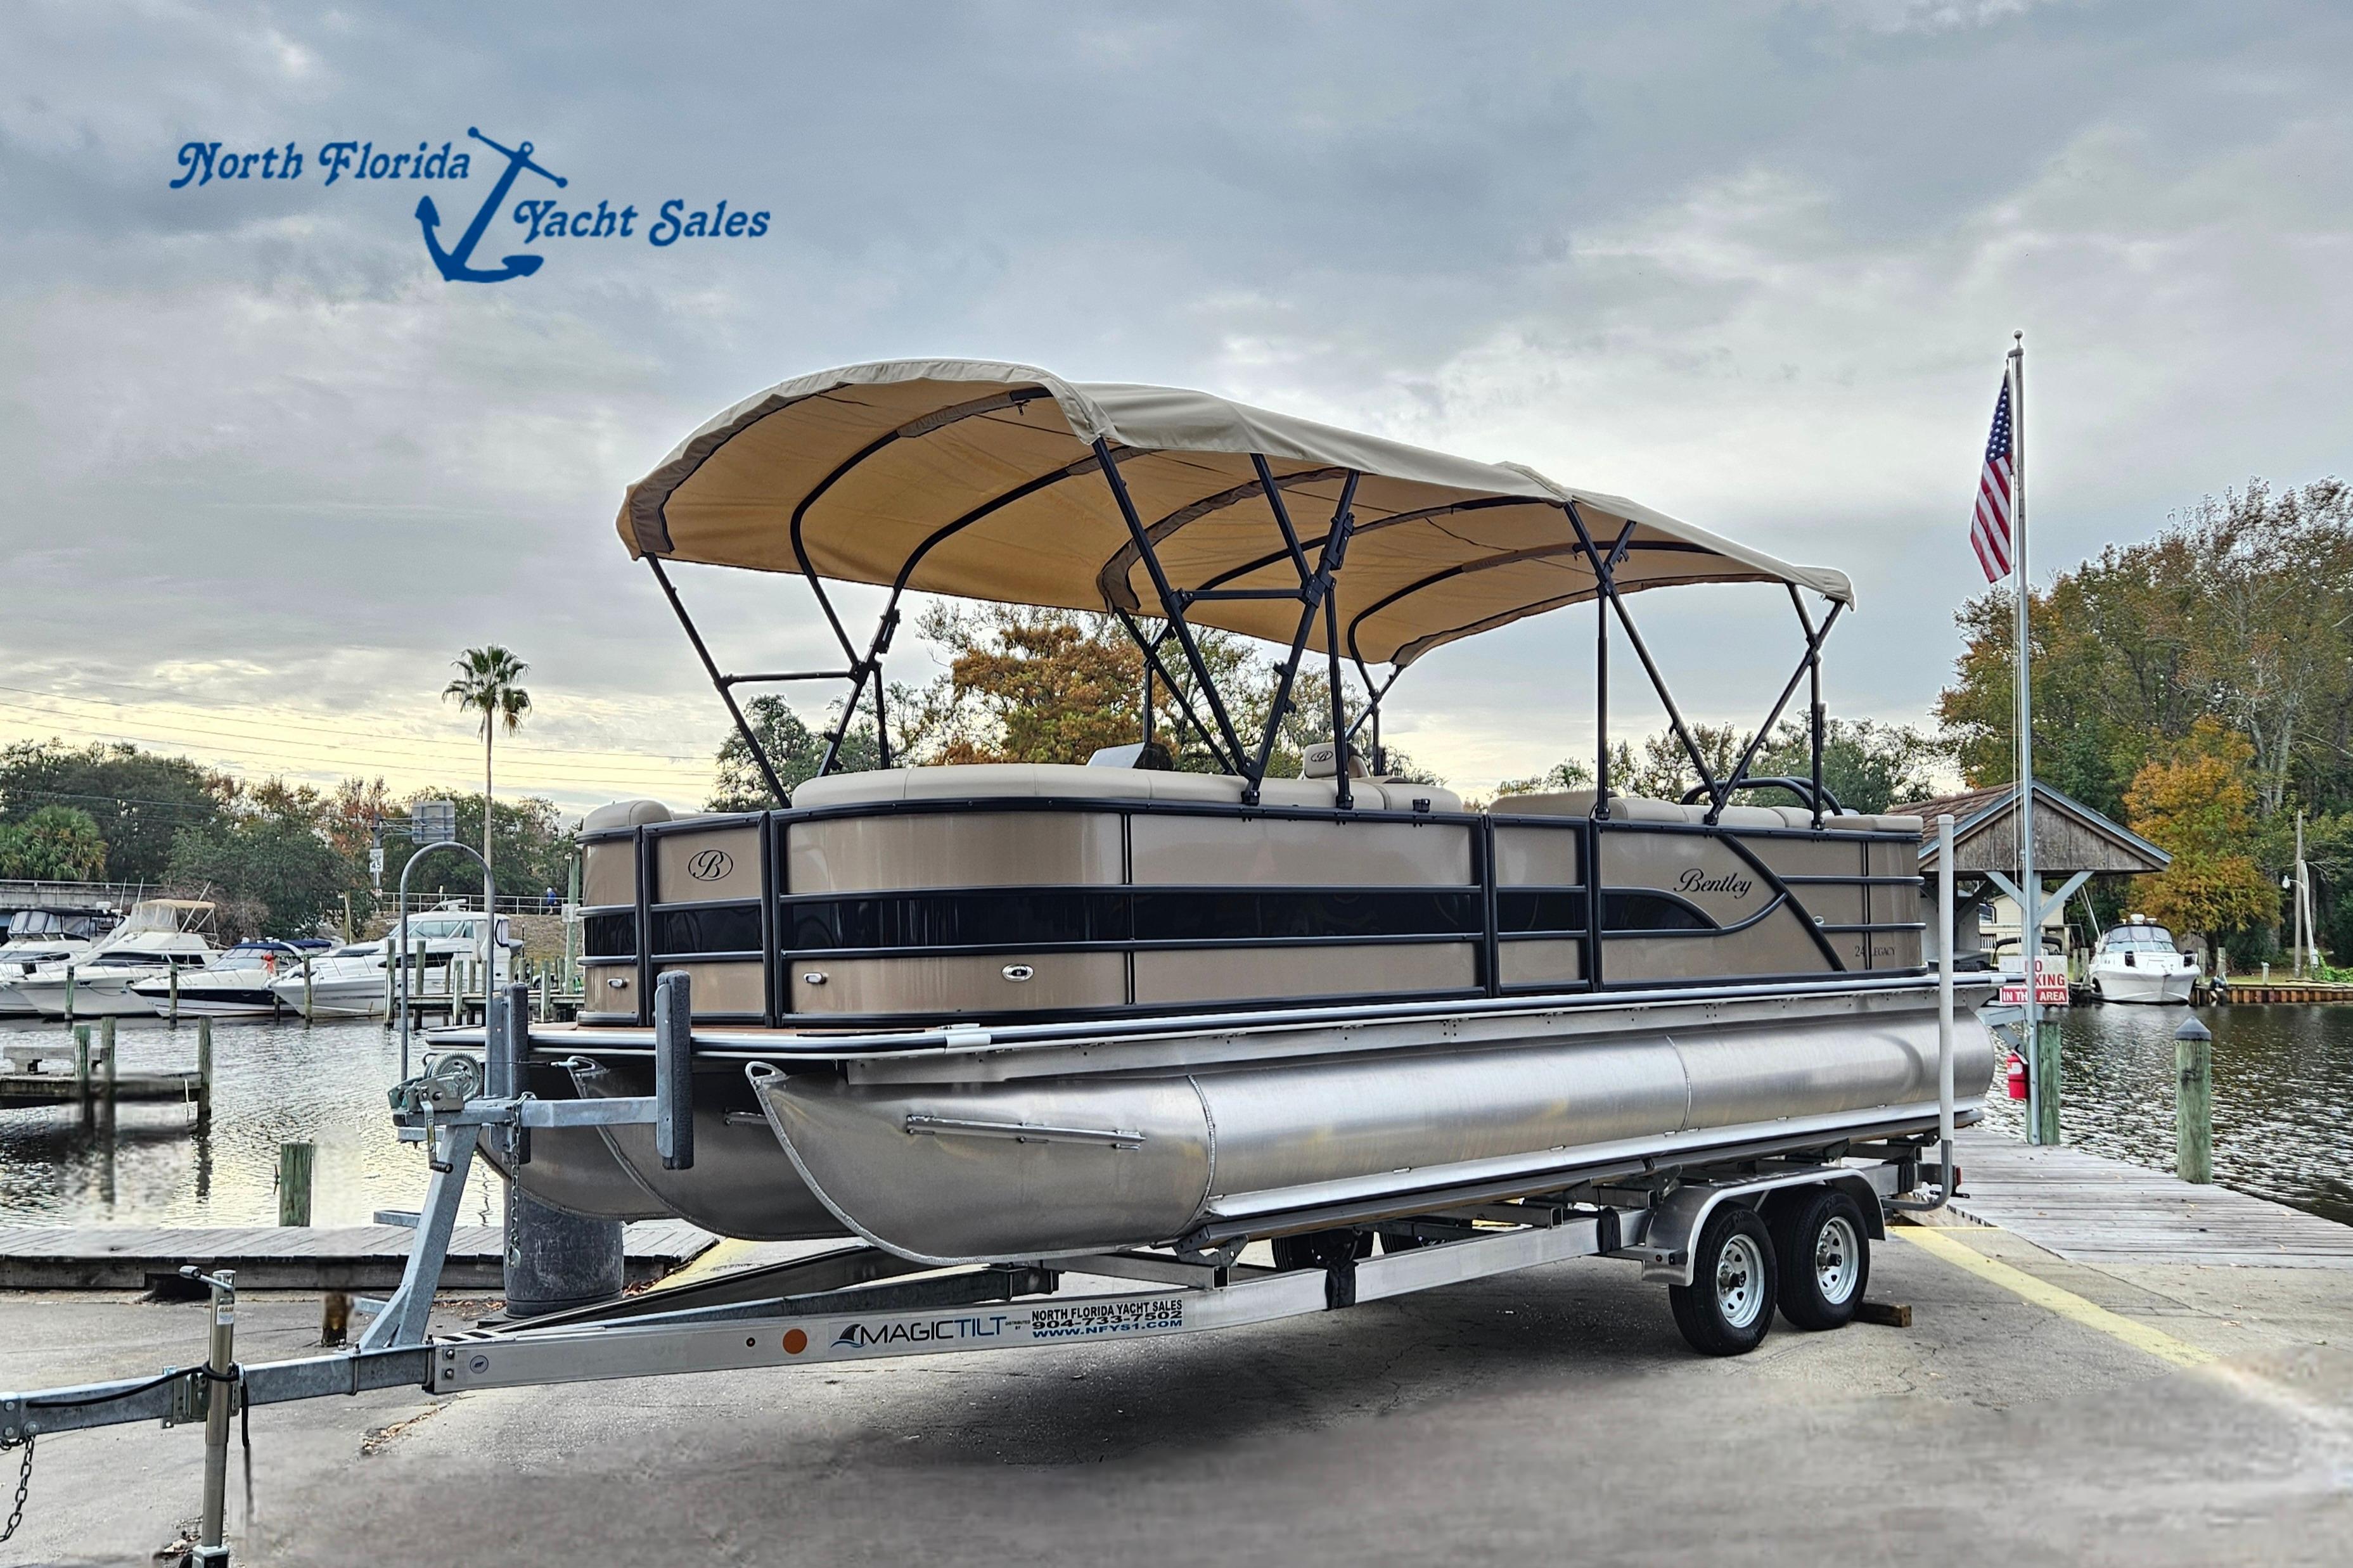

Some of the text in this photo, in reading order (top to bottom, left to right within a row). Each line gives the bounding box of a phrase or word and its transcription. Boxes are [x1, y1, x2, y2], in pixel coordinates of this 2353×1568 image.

[693, 850, 724, 879] B
[1673, 868, 1752, 900] Bentley
[1871, 947, 1895, 957] EGACY
[2003, 991, 2013, 1002] IN
[2039, 991, 2065, 1002] AREA
[1032, 1299, 1183, 1322] NORTH FLORIDA YACHT SALES
[1032, 1311, 1183, 1329] 904-733-7502
[860, 1316, 1007, 1344] MAGICTILT
